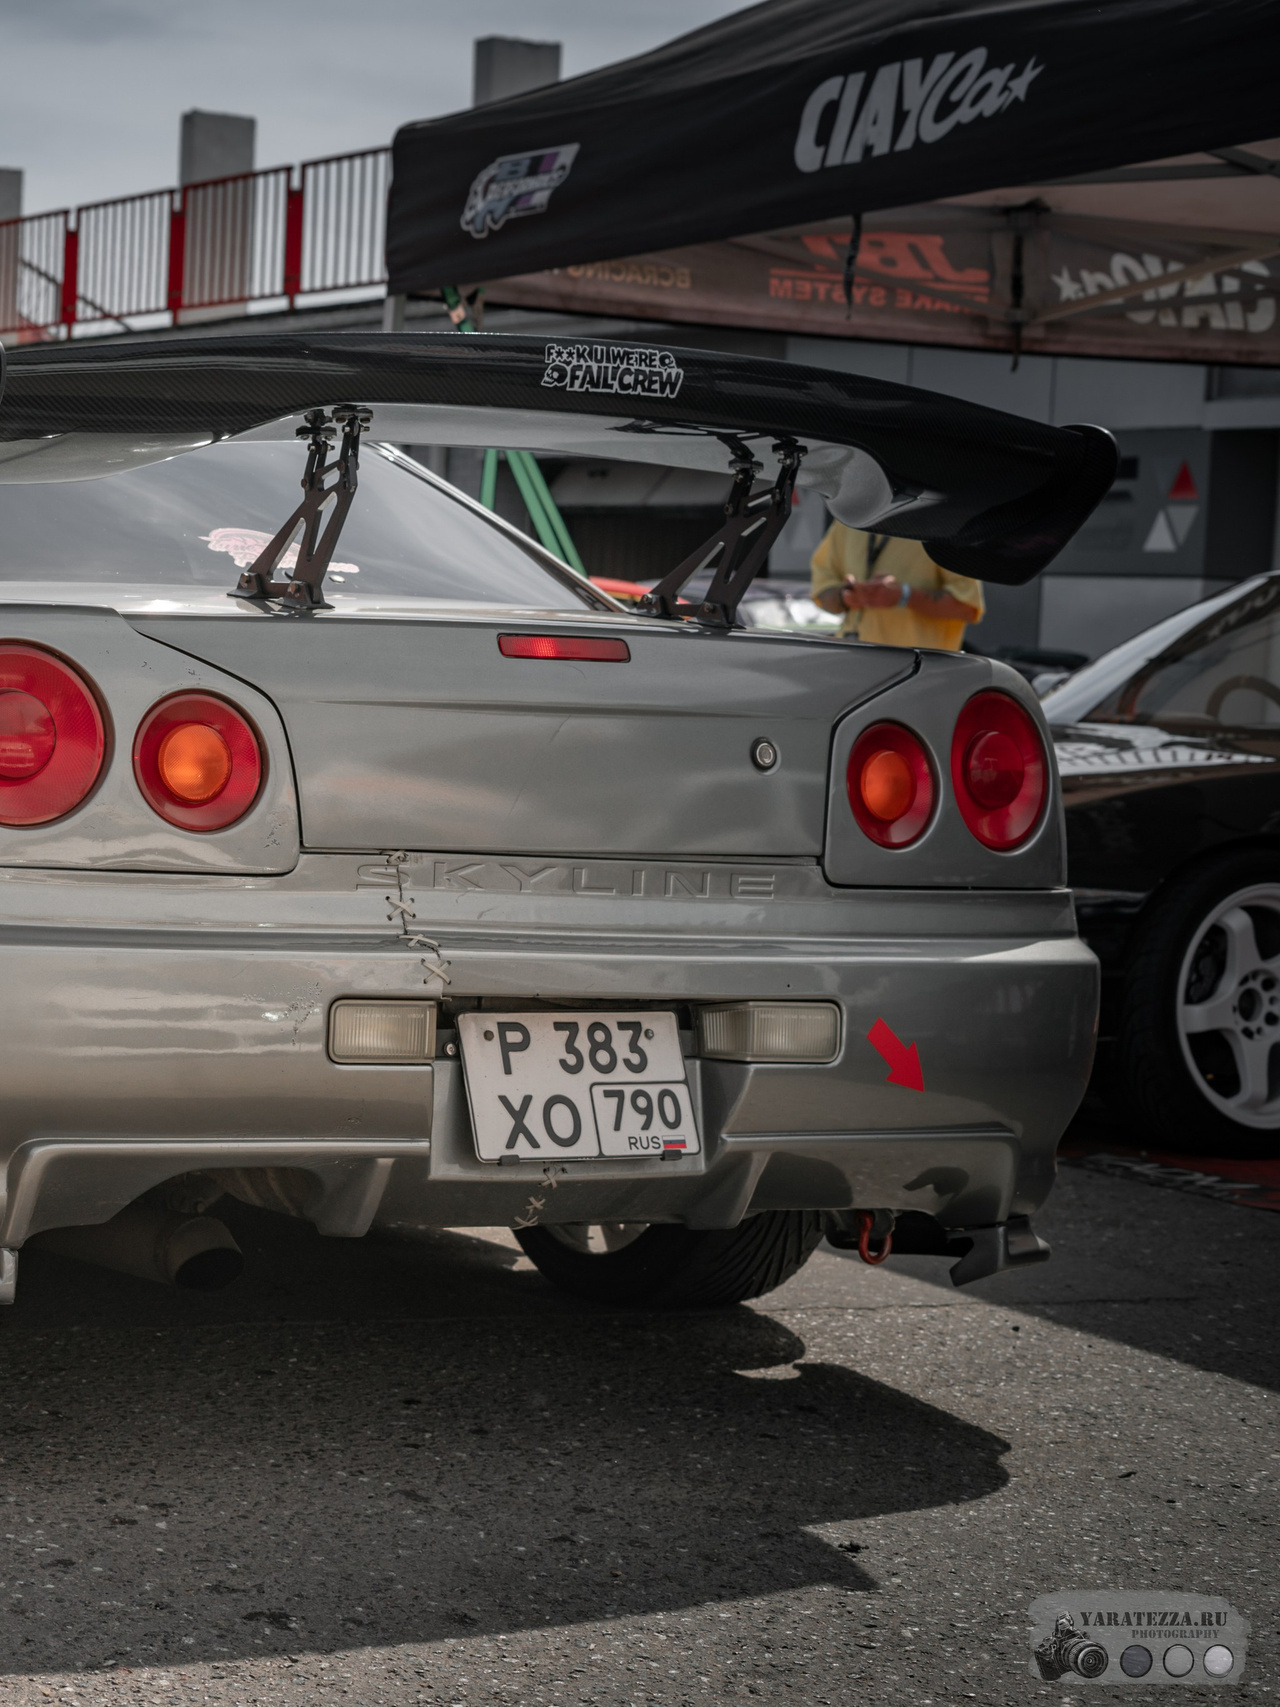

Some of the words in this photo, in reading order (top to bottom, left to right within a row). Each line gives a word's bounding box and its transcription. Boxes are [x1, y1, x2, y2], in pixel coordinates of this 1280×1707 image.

[356, 861, 776, 899] SKYLINE
[552, 1020, 649, 1075] 383
[603, 1088, 683, 1132] 790
[627, 1135, 661, 1151] RUS
